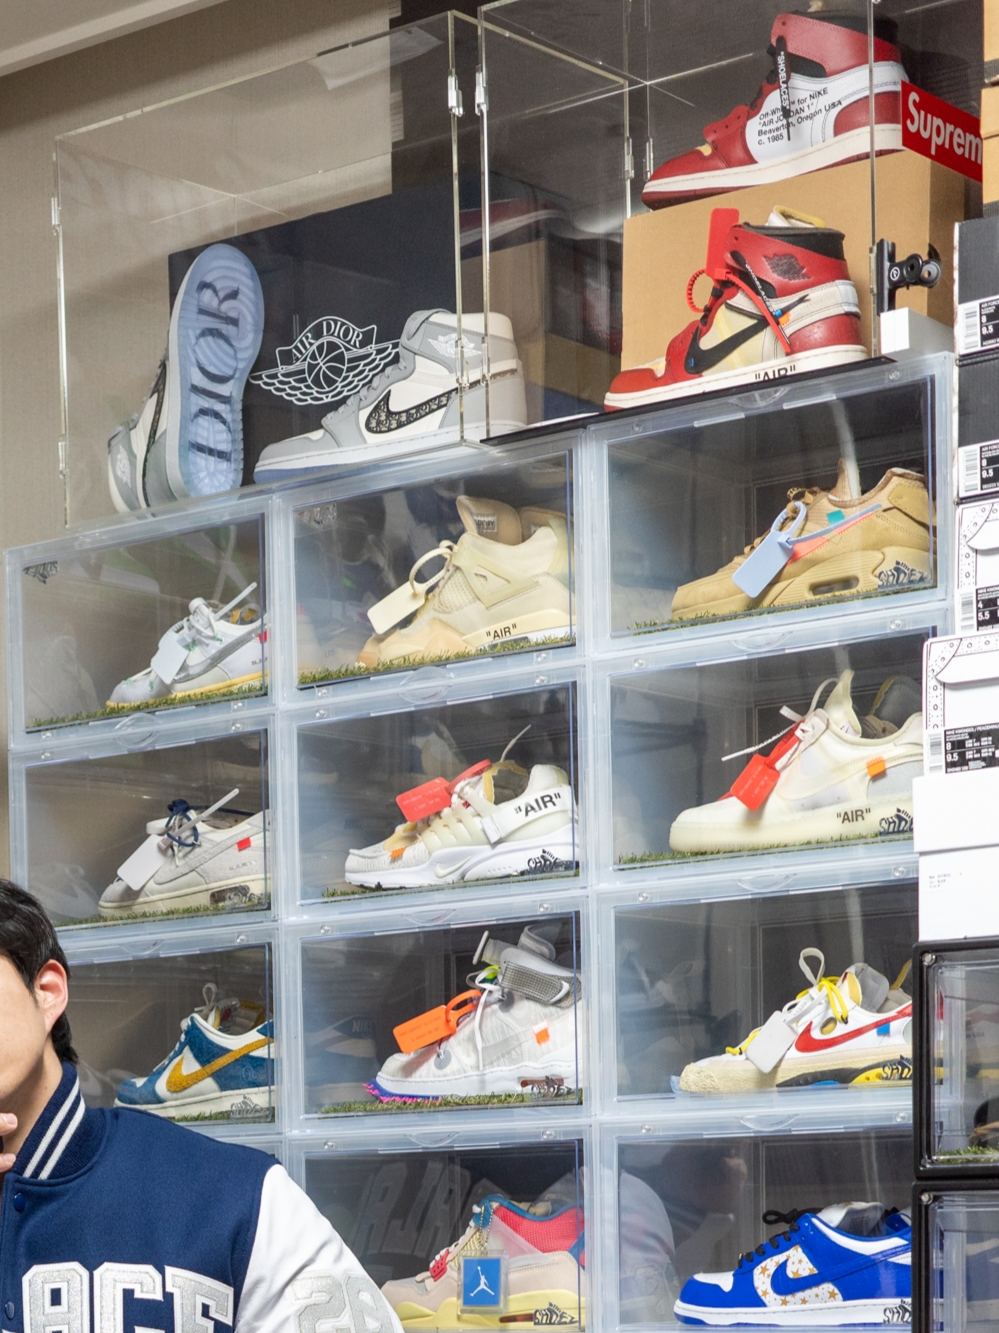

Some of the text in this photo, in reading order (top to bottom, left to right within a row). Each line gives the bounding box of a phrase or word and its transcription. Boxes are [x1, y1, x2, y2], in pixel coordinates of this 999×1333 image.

[797, 97, 807, 106] for
[809, 87, 828, 100] NIKE
[775, 107, 805, 124] JODAN
[796, 107, 822, 125] Oregon
[824, 100, 843, 112] USA
[767, 133, 784, 144] 1985
[981, 324, 994, 335] 9.5
[290, 319, 364, 364] AIR DIOR
[189, 280, 240, 462] DIOR
[981, 468, 994, 479] 9.5
[978, 610, 990, 621] 5.5
[485, 622, 517, 640] "AIR"
[945, 741, 952, 751] 8
[946, 752, 959, 762] 9.5
[514, 792, 562, 817] "AIR"
[836, 807, 871, 824] "AIR"
